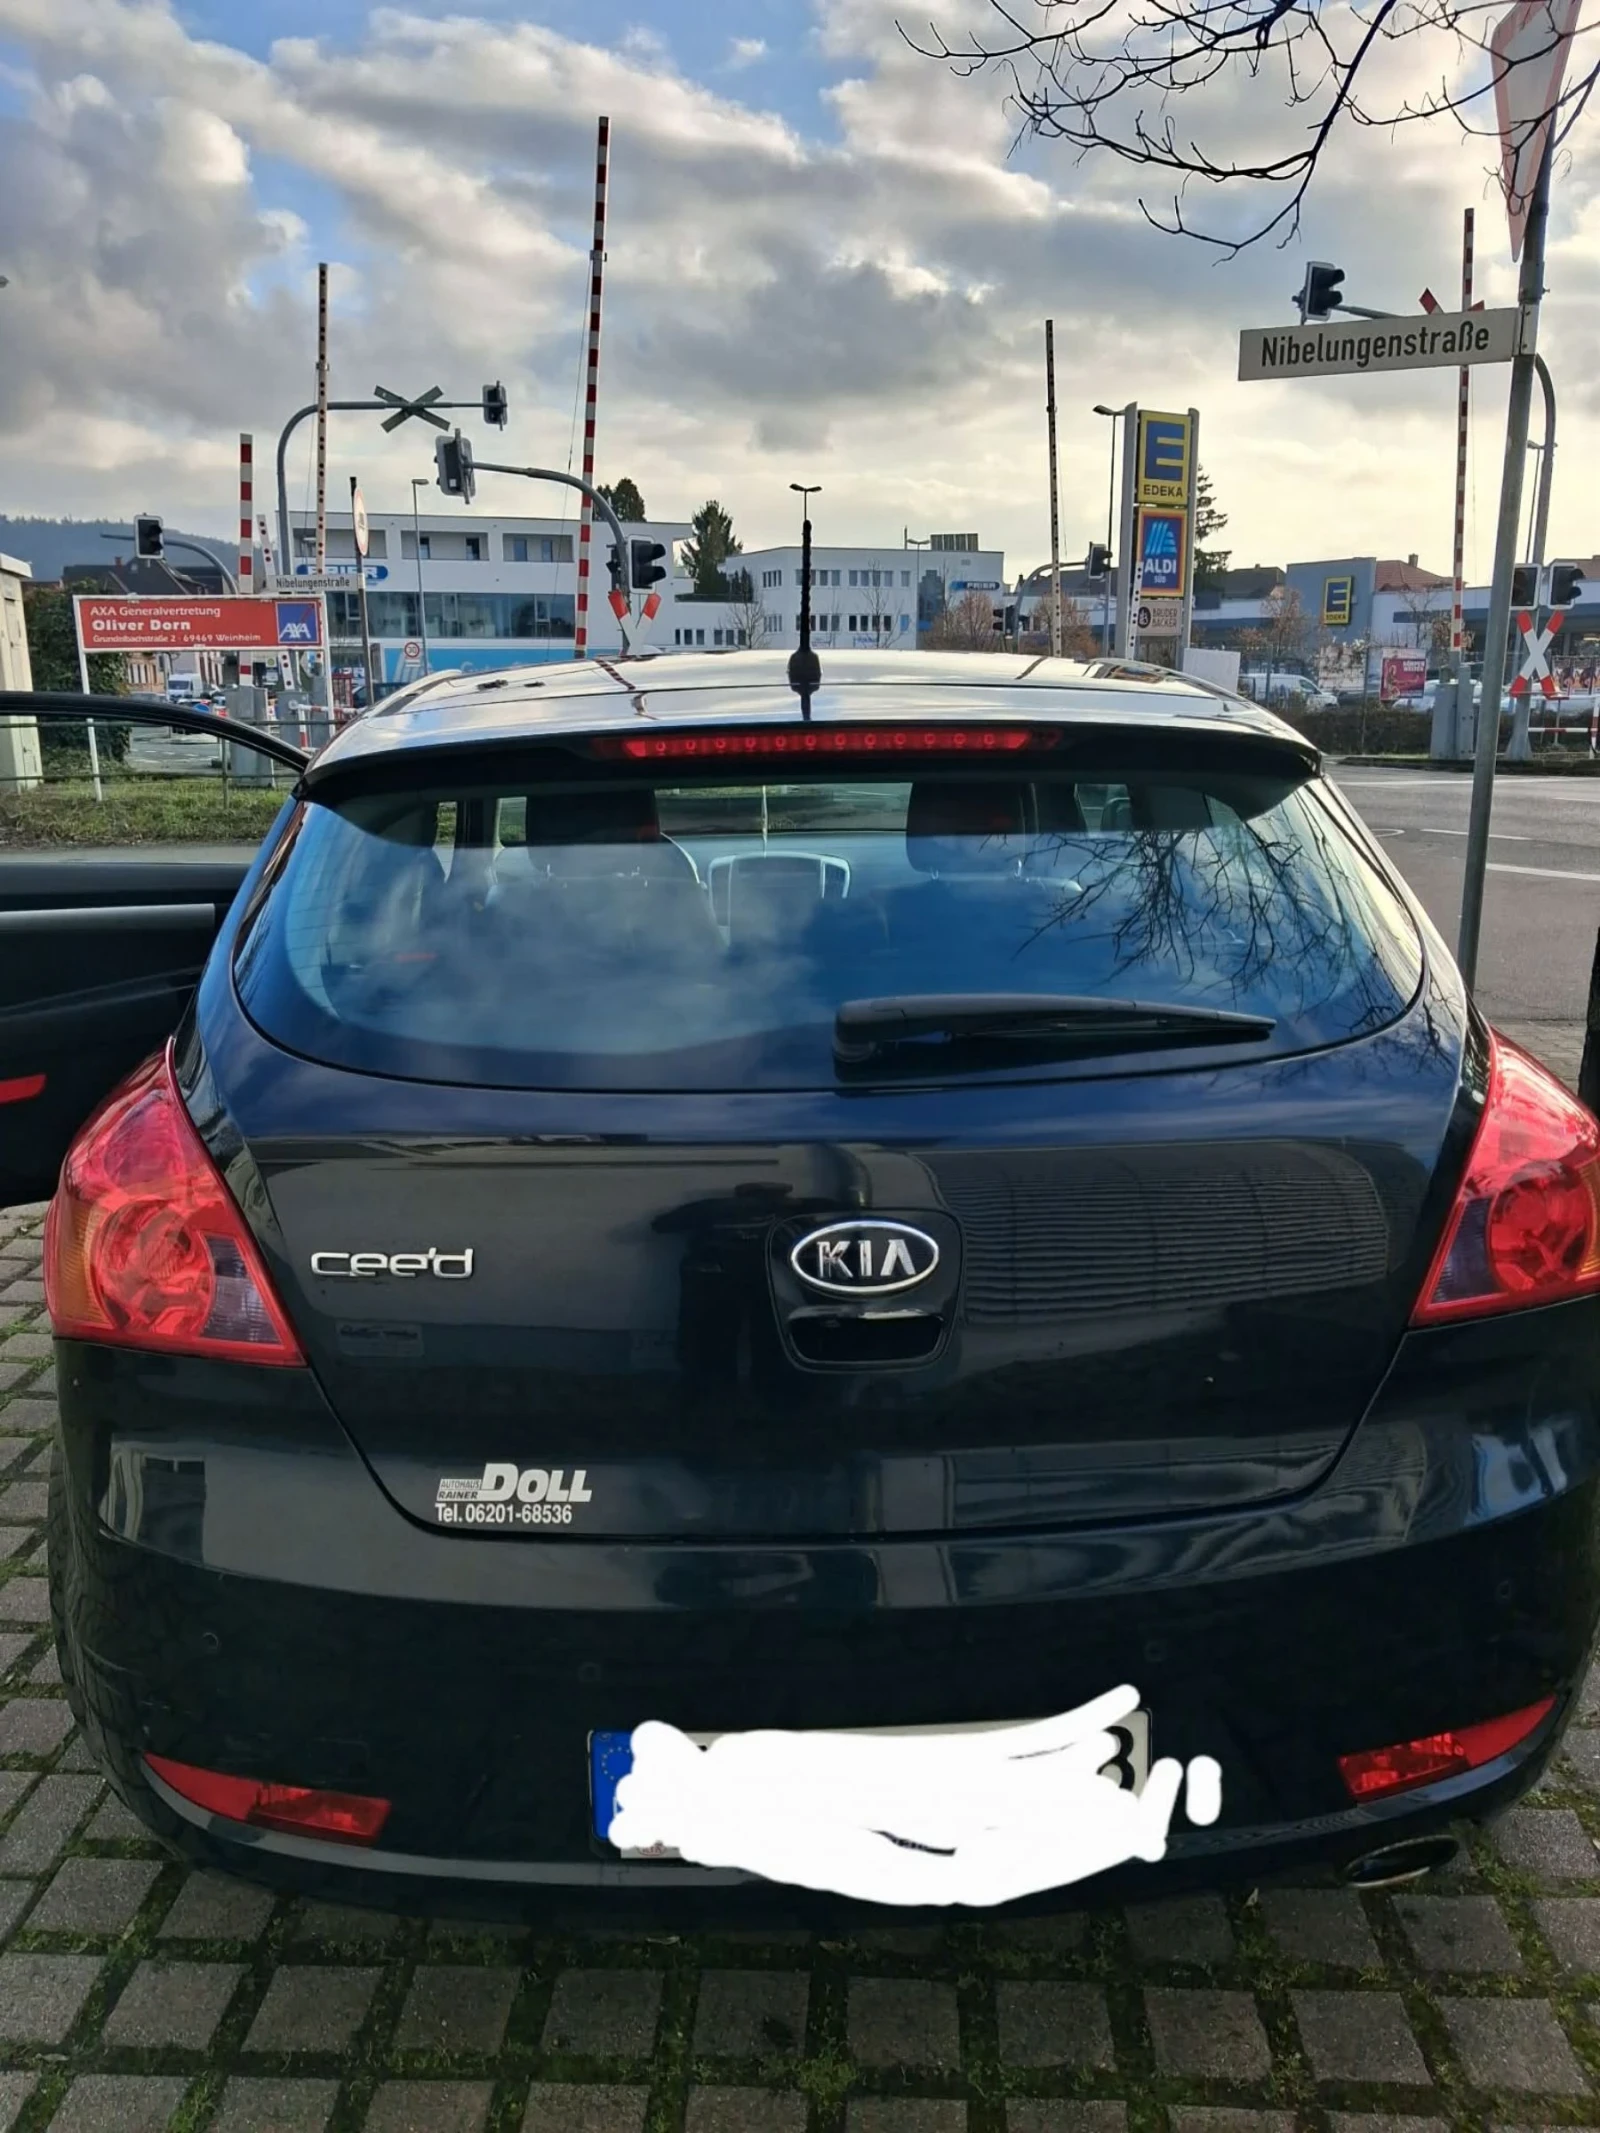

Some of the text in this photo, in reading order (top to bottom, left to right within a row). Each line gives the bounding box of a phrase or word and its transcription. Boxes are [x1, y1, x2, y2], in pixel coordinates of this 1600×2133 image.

[1261, 320, 1489, 368] Nibelungenstraße
[1143, 484, 1184, 498] EDEKA
[1144, 558, 1177, 574] ALDI
[276, 577, 350, 590] Nibelungenstraße
[91, 606, 221, 618] AXA Generalvertretung
[92, 619, 191, 631] Oliver Dorn
[280, 622, 312, 639] AXA
[183, 634, 213, 642] 69469
[215, 633, 261, 641] Weinheim
[311, 1247, 473, 1279] cee'd
[817, 1239, 917, 1278] KIA
[440, 1480, 481, 1490] AUTOHAUS
[481, 1463, 593, 1503] DOLL
[438, 1490, 479, 1500] RAINER
[435, 1503, 573, 1524] Tel. 06201-68536
